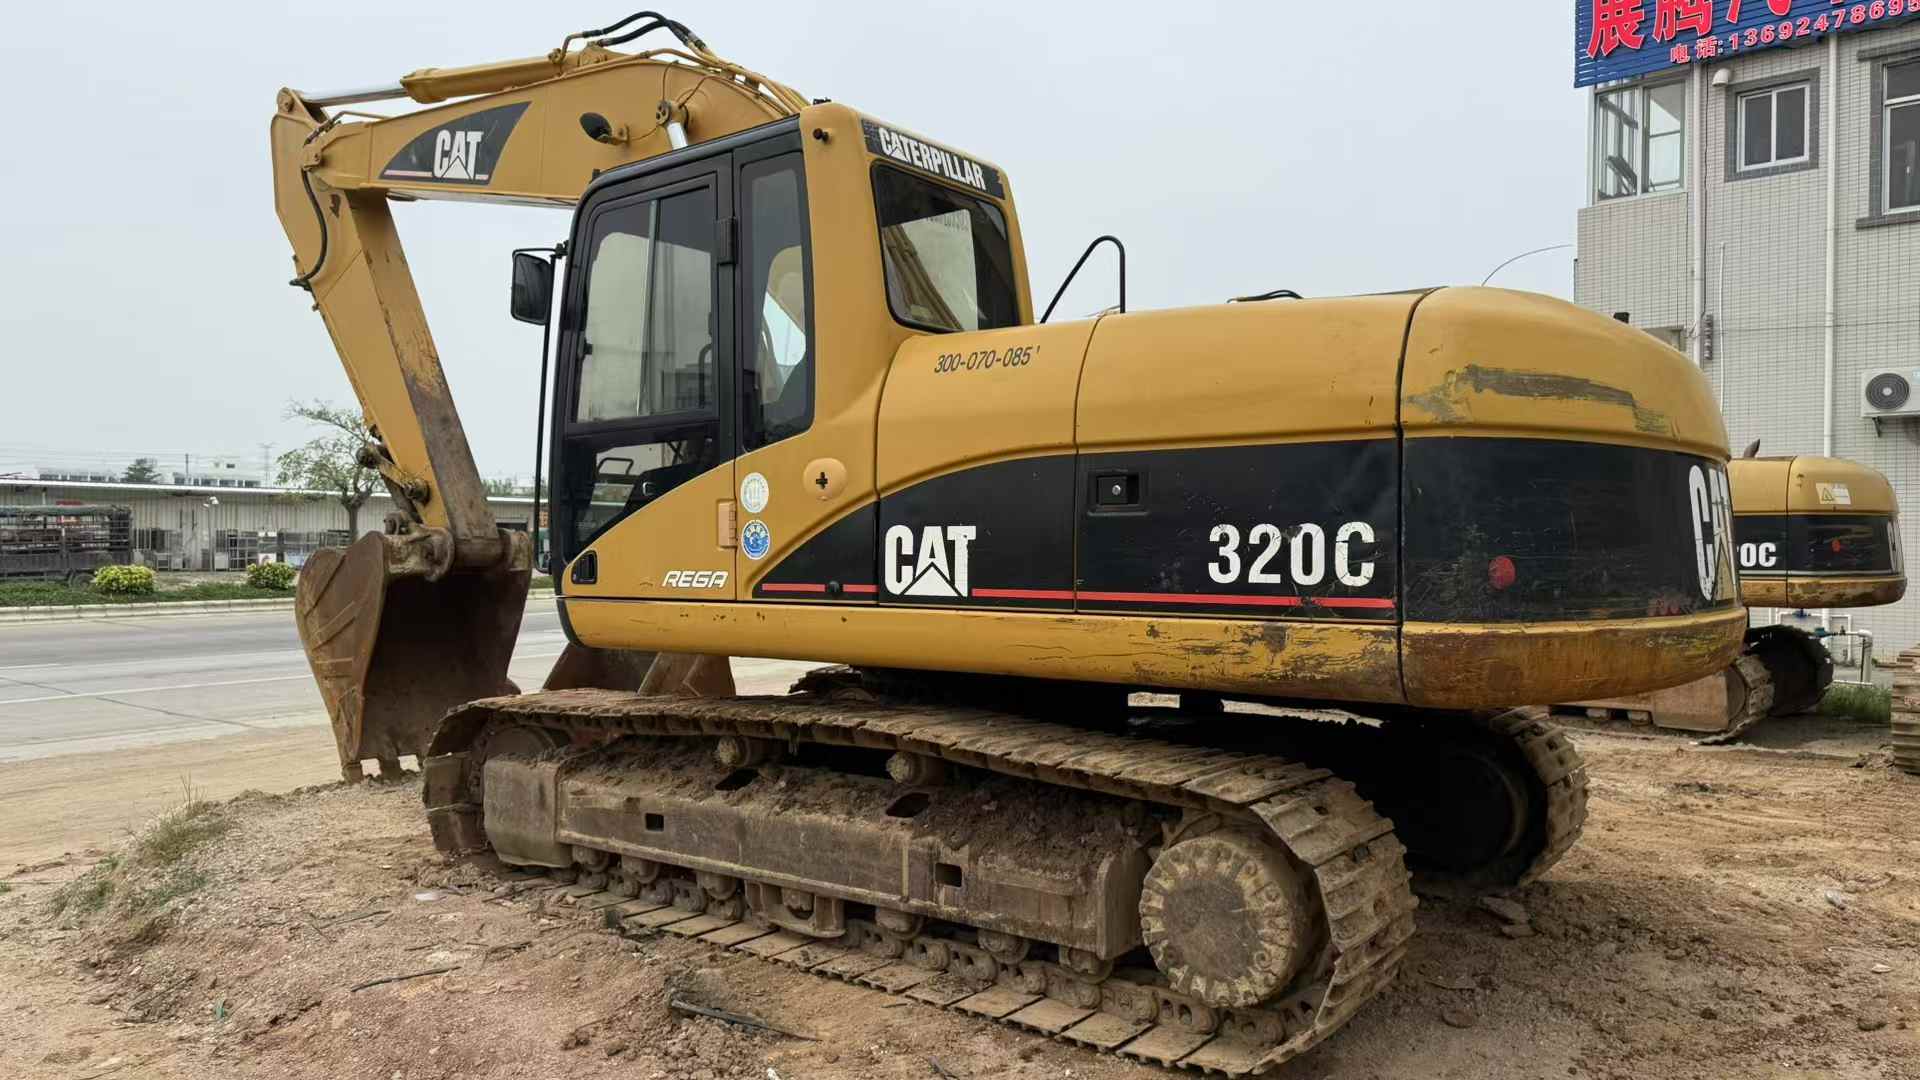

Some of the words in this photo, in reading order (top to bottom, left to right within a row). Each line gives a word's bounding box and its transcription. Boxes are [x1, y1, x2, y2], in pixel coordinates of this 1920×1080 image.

[433, 129, 485, 180] CAT
[878, 127, 987, 190] CATERPILLAR
[661, 570, 729, 589] REGA
[885, 524, 977, 598] CAT
[1208, 521, 1376, 587] 320C
[1736, 542, 1777, 568] 0C
